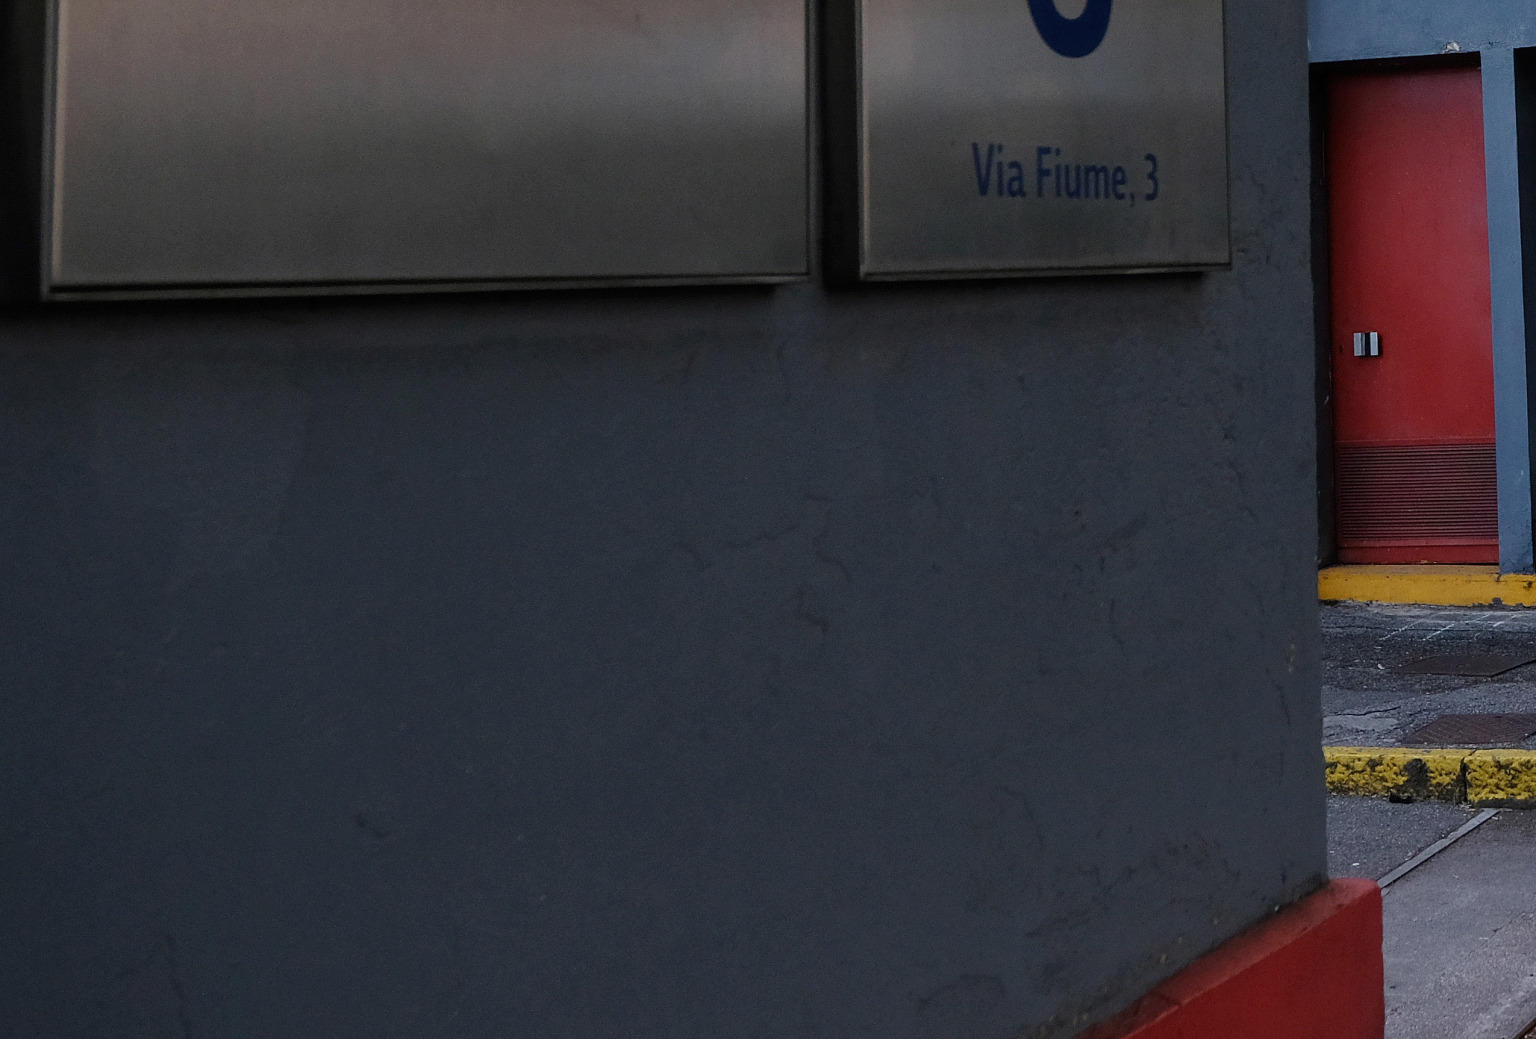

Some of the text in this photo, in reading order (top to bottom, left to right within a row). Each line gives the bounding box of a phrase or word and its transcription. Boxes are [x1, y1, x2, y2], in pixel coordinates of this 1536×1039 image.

[972, 142, 1159, 207] Via Fiume, 3
